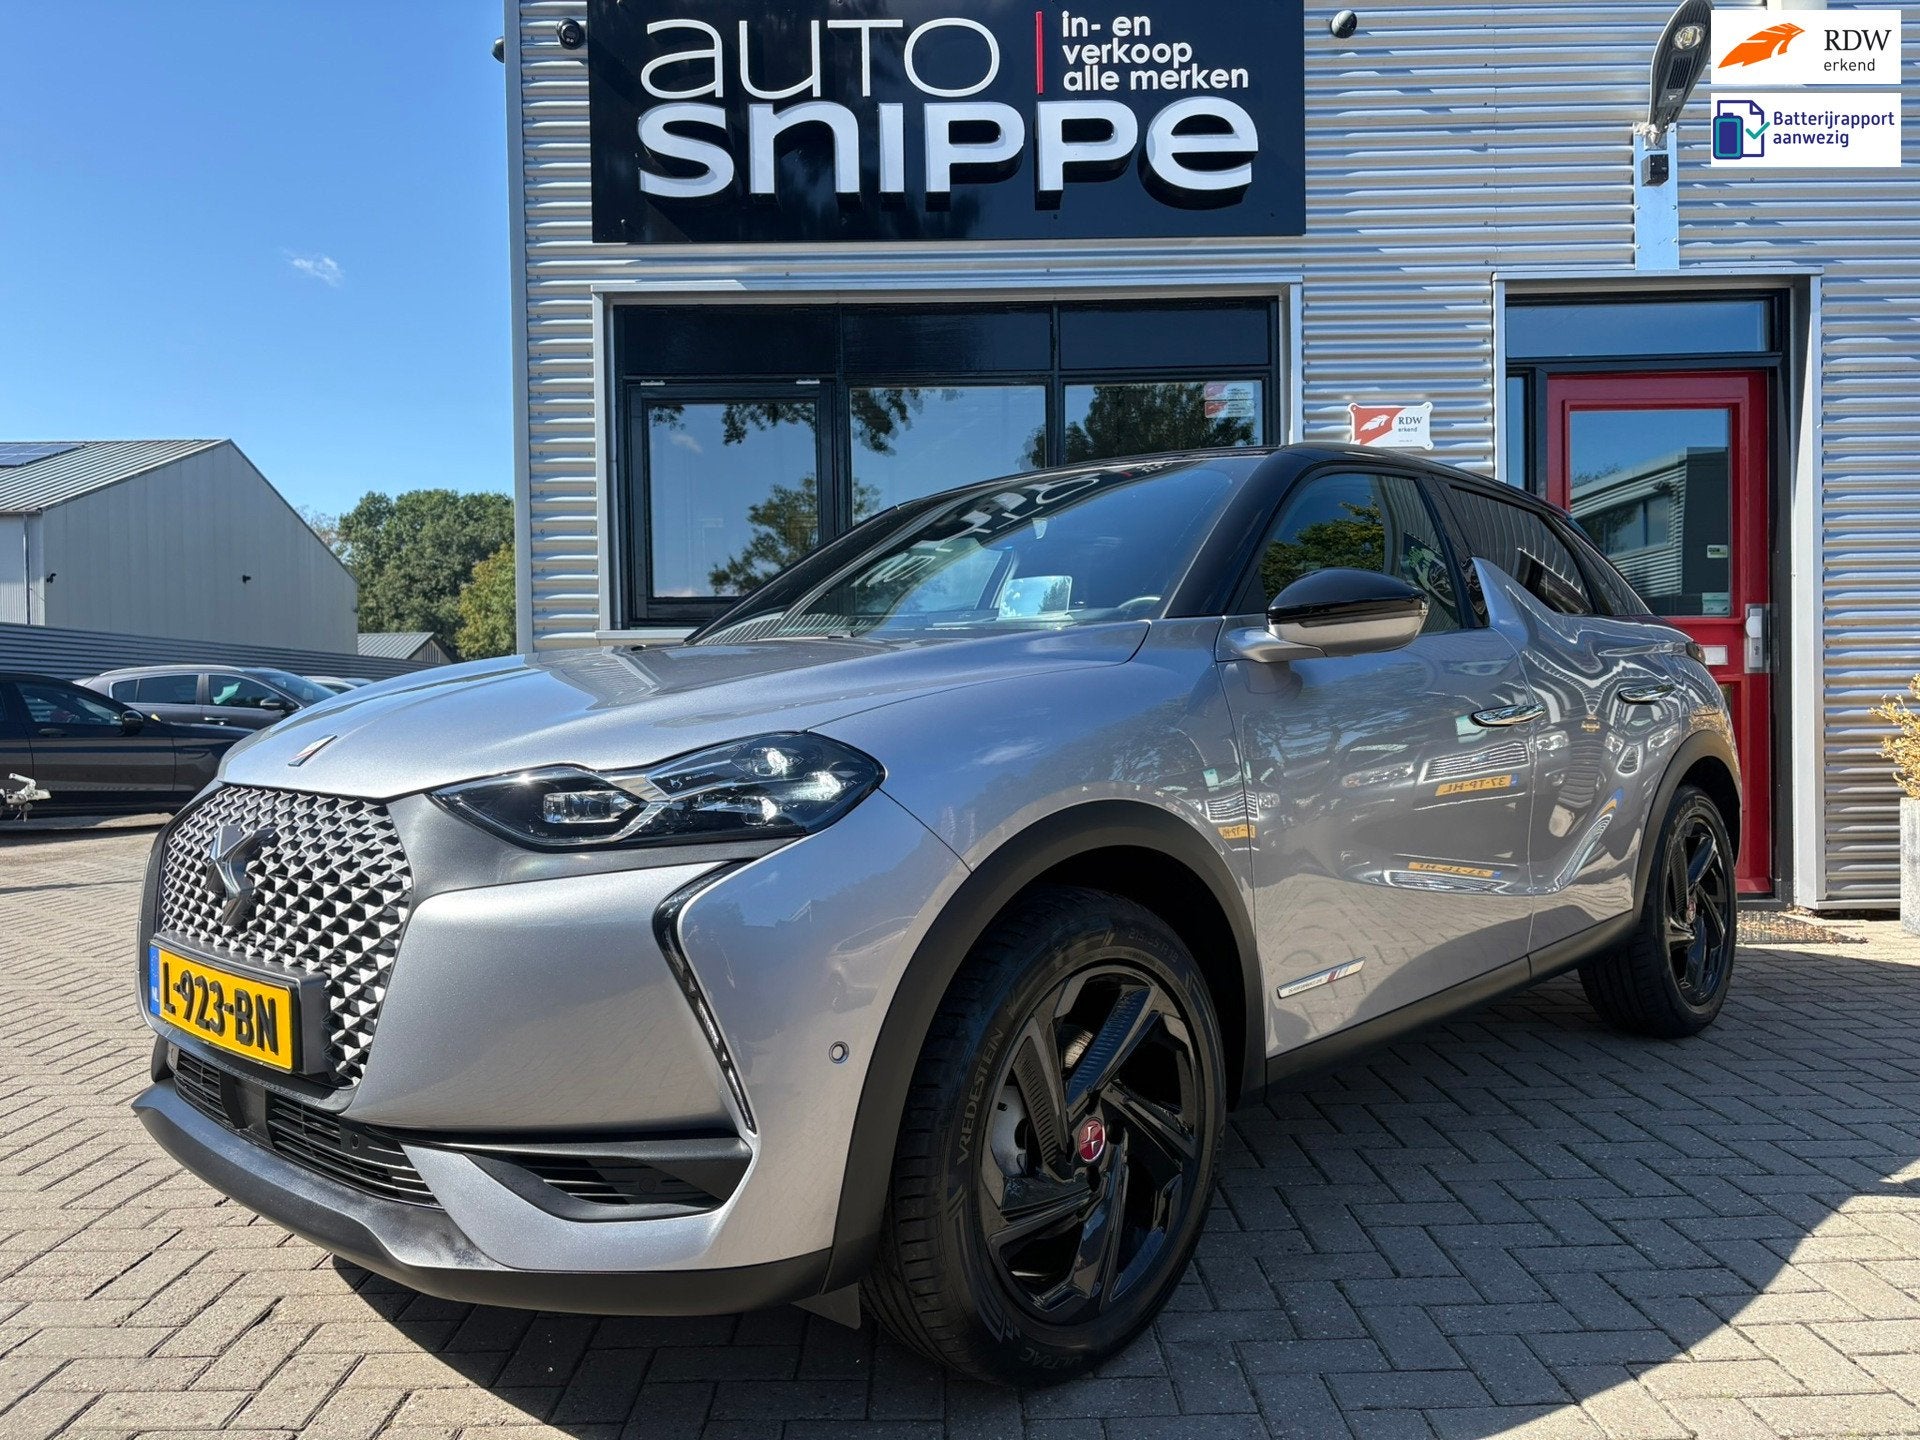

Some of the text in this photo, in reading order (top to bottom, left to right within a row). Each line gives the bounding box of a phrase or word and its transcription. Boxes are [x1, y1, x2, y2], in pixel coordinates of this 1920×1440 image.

[1061, 11, 1151, 38] in- en
[1061, 39, 1193, 72] verkoop
[1062, 63, 1250, 92] alle merken
[1398, 416, 1422, 425] RDW
[163, 961, 279, 1056] L-923-BN
[956, 1027, 1005, 1166] VREDESTEIN
